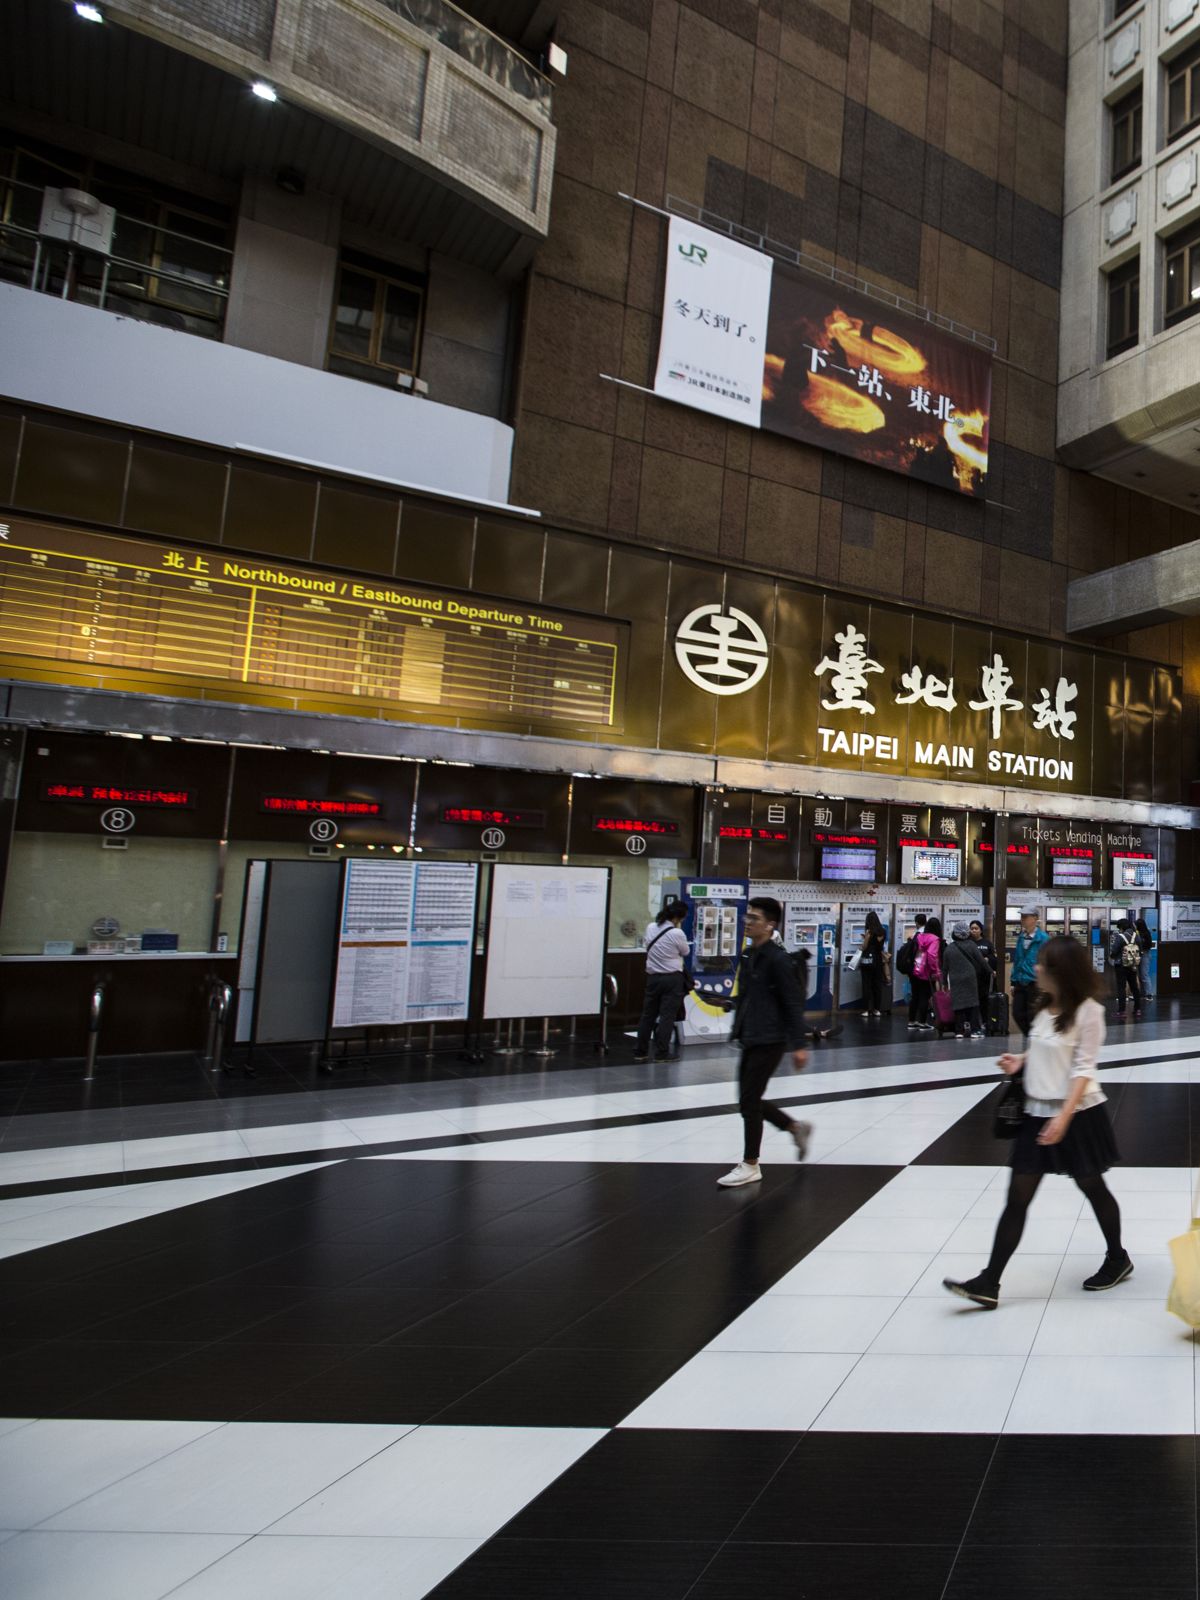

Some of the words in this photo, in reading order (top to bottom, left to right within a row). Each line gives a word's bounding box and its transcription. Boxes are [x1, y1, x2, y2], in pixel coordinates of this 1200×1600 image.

[678, 243, 708, 264] JR
[673, 299, 756, 343] 冬天到了。
[163, 551, 210, 574] 北上
[223, 562, 336, 594] Northbound
[340, 583, 348, 596] /
[352, 585, 442, 612] Eastbound
[447, 601, 524, 625] Departure
[528, 614, 563, 632] Time
[814, 624, 1078, 740] 臺北車站
[818, 728, 898, 760] TAIPEI
[915, 742, 974, 769] MAIN
[988, 751, 1073, 780] STATION
[111, 810, 126, 829] 8
[317, 821, 330, 838] 9
[767, 803, 959, 836] 自動售票機
[487, 831, 500, 845] 10
[1022, 826, 1061, 842] Tickets
[1065, 830, 1102, 846] Vending
[1107, 833, 1142, 847] Machine
